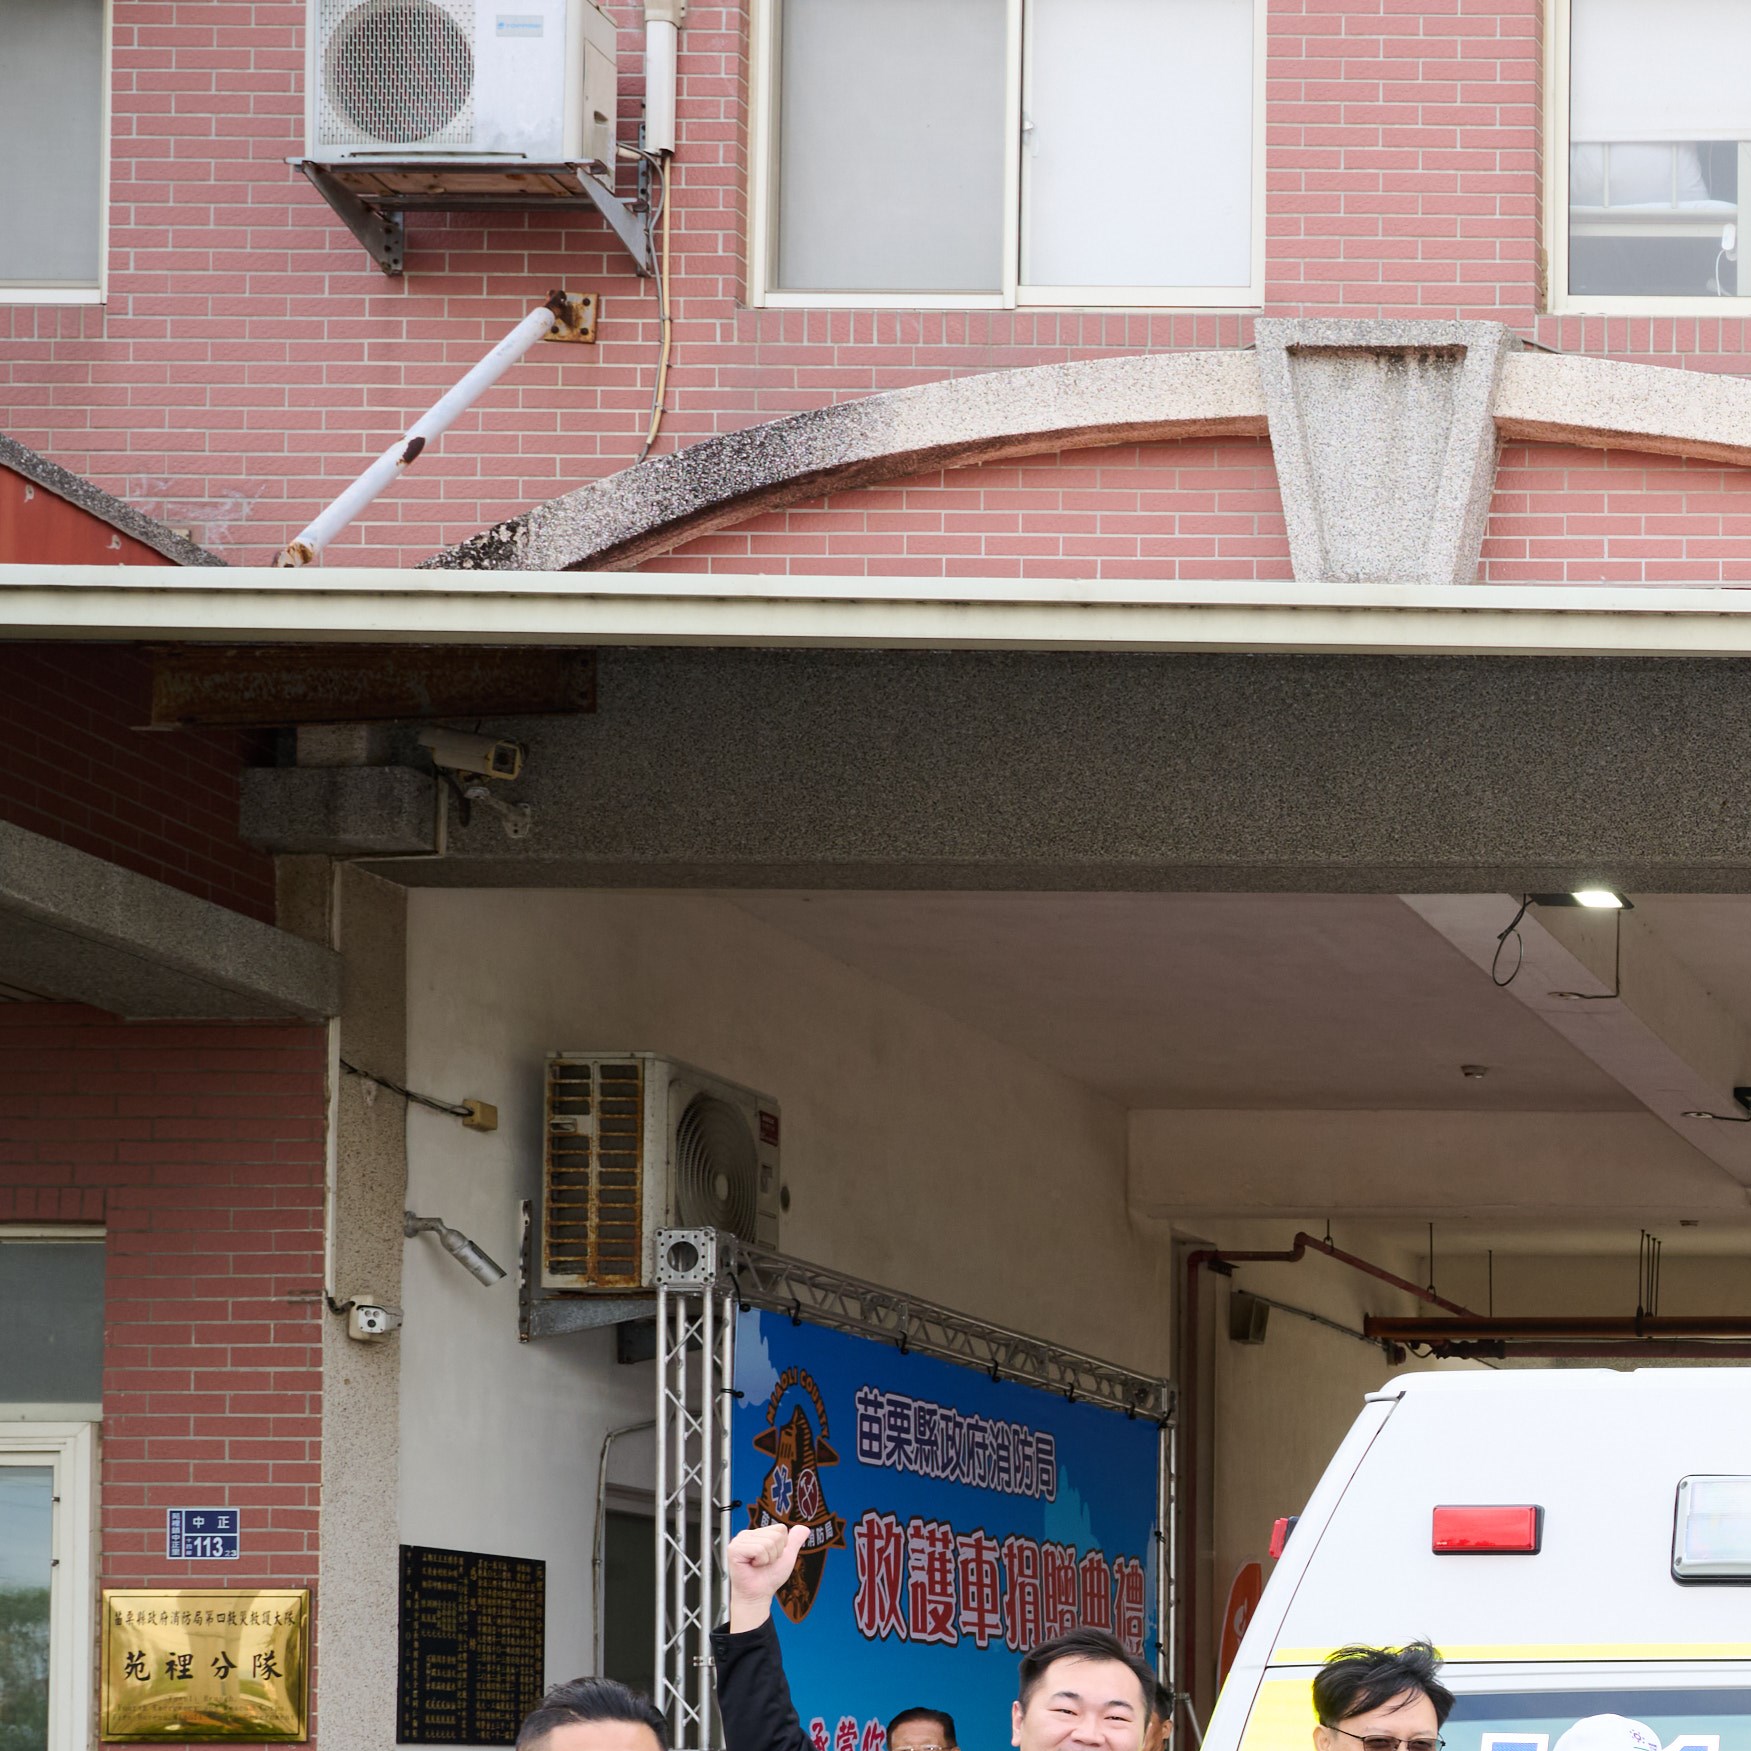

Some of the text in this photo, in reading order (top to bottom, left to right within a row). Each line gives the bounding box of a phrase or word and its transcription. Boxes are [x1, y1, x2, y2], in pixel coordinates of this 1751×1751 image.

[856, 1387, 1057, 1501] 苗栗縣政府消防局
[192, 1516, 230, 1529] 中正
[193, 1537, 223, 1557] 113
[855, 1511, 1145, 1657] 救護車捐贈典禮
[124, 1650, 284, 1682] 苑裡分隊
